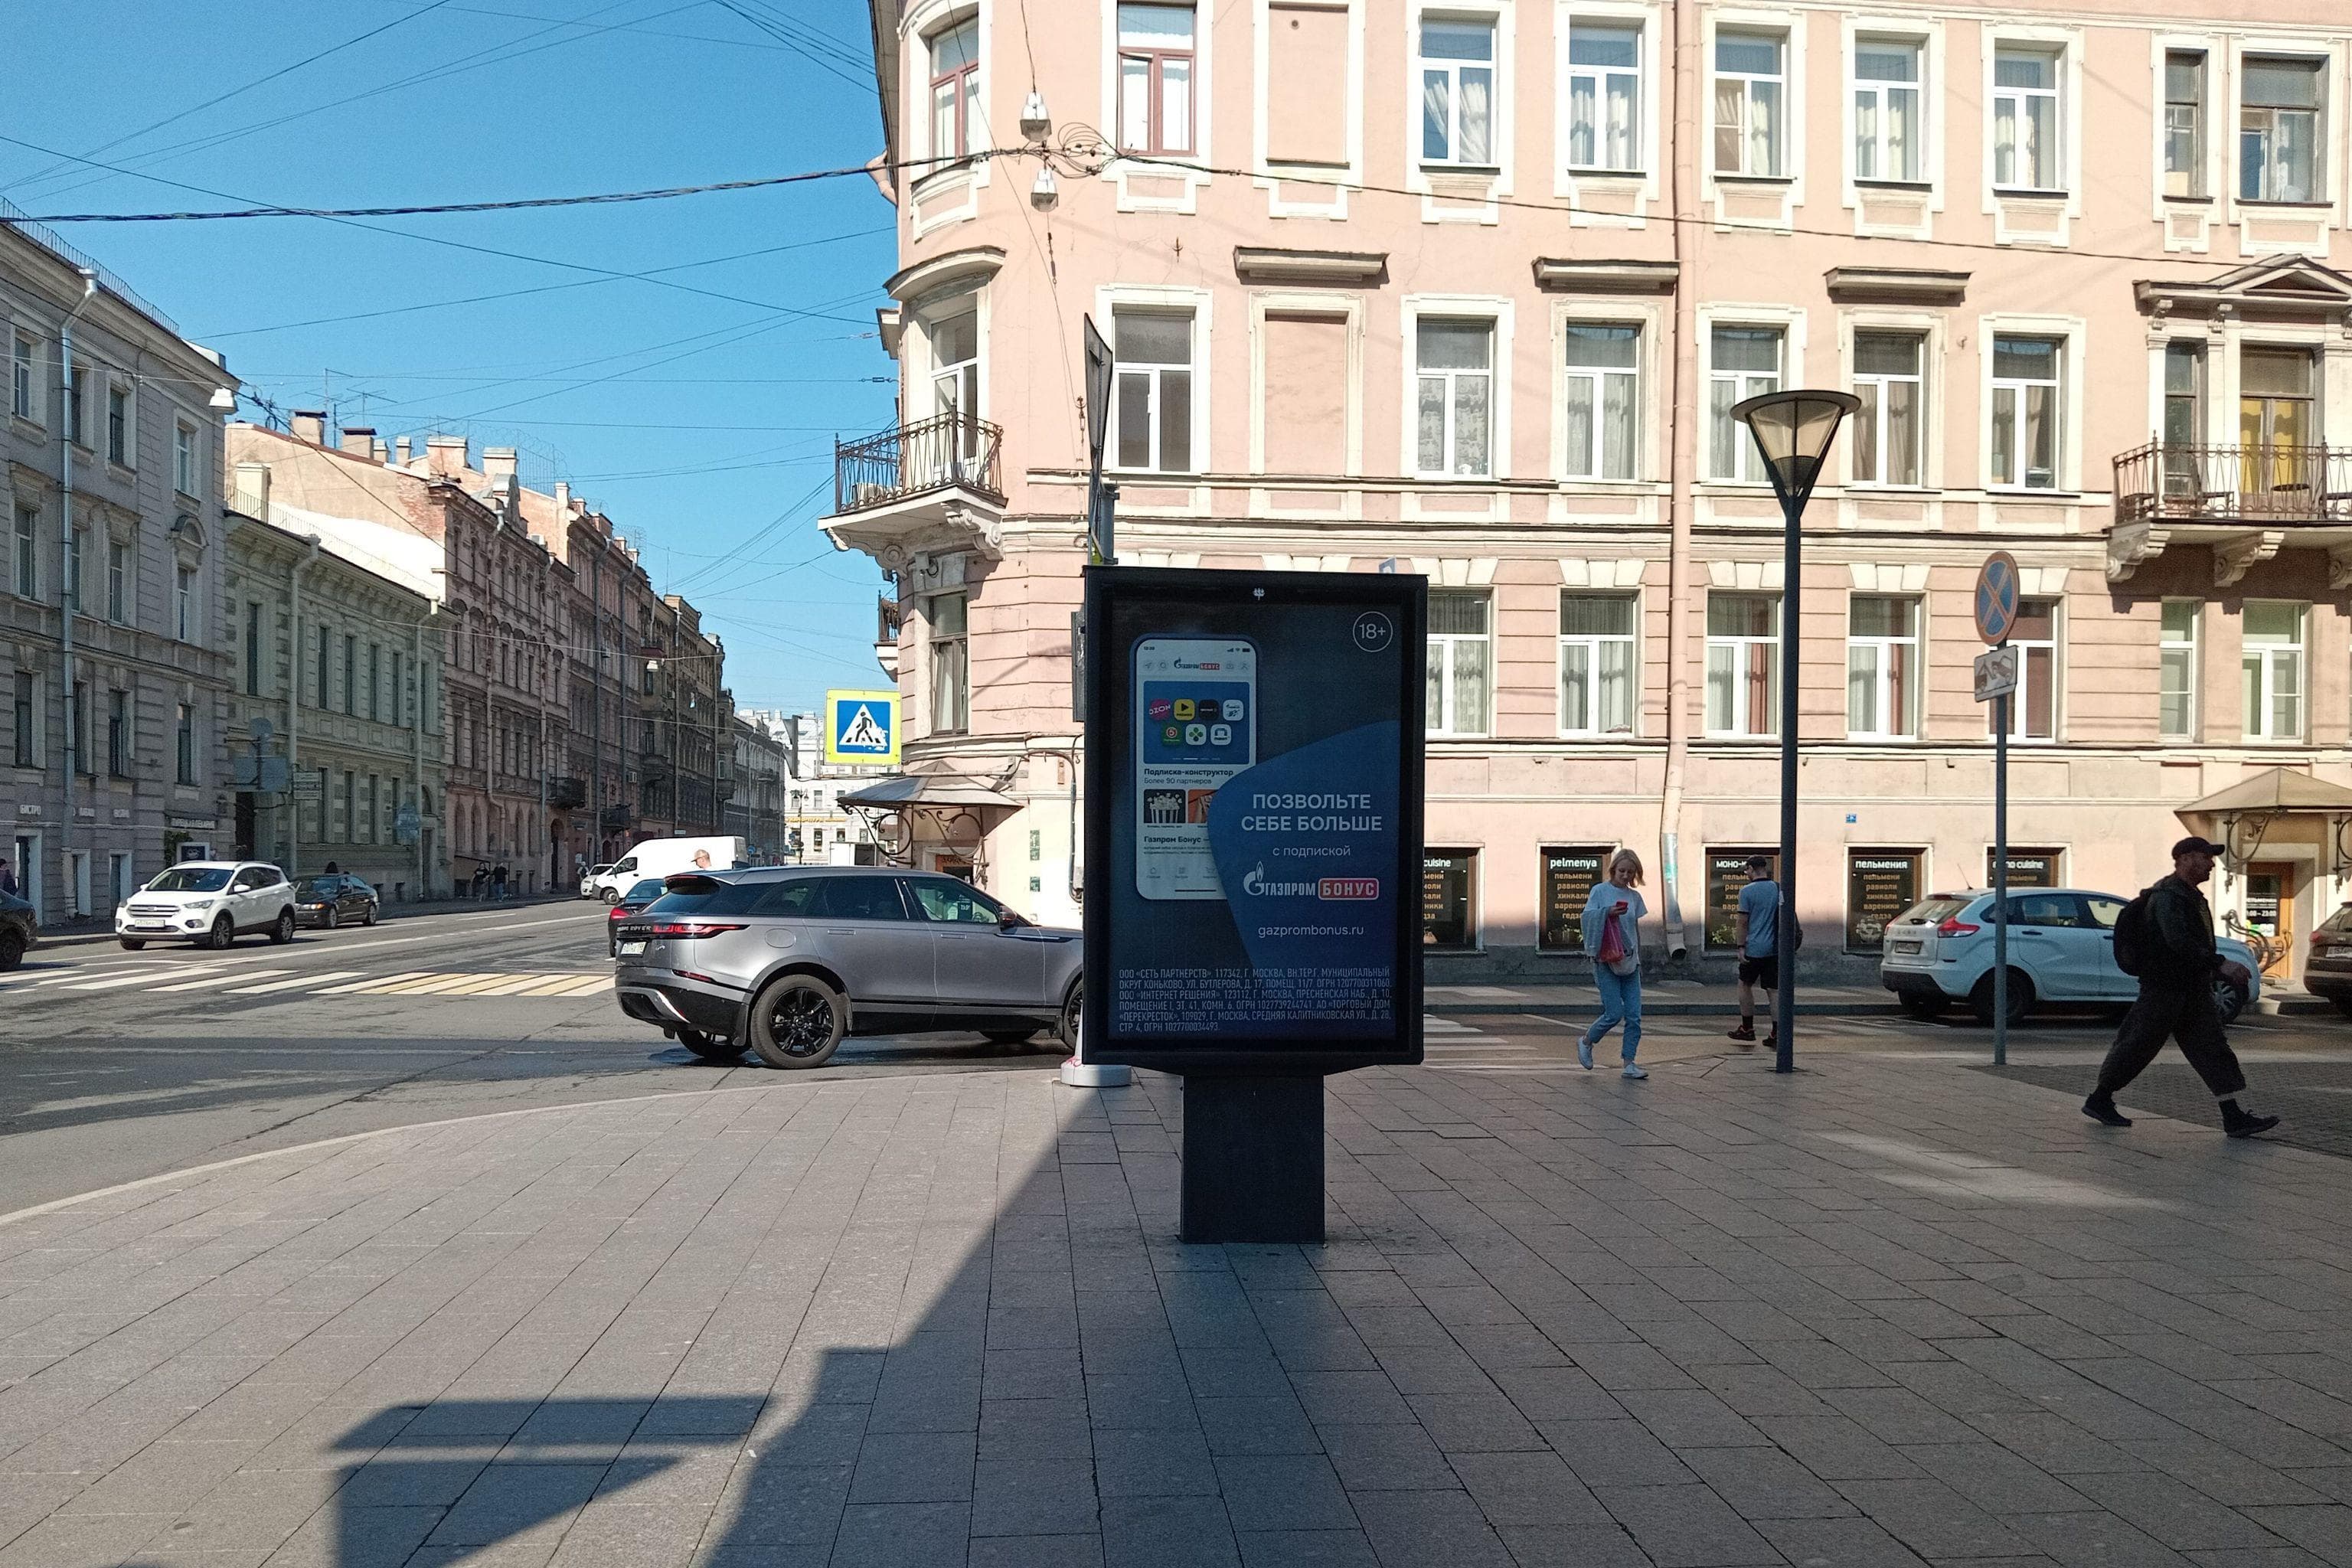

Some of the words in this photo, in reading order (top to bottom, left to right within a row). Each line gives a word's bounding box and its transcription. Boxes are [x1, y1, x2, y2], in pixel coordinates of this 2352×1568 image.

[1359, 623, 1387, 639] 18+
[1144, 768, 1234, 778] Подписка-конструктор
[1253, 794, 1371, 809] ПОЗВОЛЬТЕ
[1241, 815, 1292, 831] СЕБЕ
[1297, 815, 1383, 831] БОЛЬШЕ
[1178, 836, 1201, 844] Бонус
[1272, 847, 1280, 856] с
[1283, 845, 1351, 858] подпиской
[1550, 858, 1598, 870] pelmenya
[1855, 861, 1908, 869] пельмения
[1265, 883, 1316, 896] ГАЗПРОМ
[1322, 882, 1374, 896] БОНУС
[1258, 925, 1364, 939] gazprombonus.ru
[1119, 969, 1135, 978] ООО
[1321, 966, 1390, 978] МУНИЦИПАЛЬНЫЙ
[1119, 979, 1142, 989] ОКРУГ
[1144, 979, 1184, 990] КОНЬКОВО,
[1317, 978, 1335, 988] ОГРН
[1119, 990, 1135, 1000] ООО
[1296, 988, 1349, 999] ПРЕСНЕНСКАЯ
[1119, 1001, 1168, 1011] ПОМЕЩЕНИЕ
[1236, 1000, 1256, 1010] ОГРН
[1316, 999, 1327, 1009] АО
[1374, 999, 1391, 1010] ДОМ
[1252, 1010, 1286, 1021] СРЕДНЯЯ
[1287, 1010, 1355, 1021] КАЛИТНИКОВСКАЯ
[1144, 1022, 1163, 1032] ОГРН
